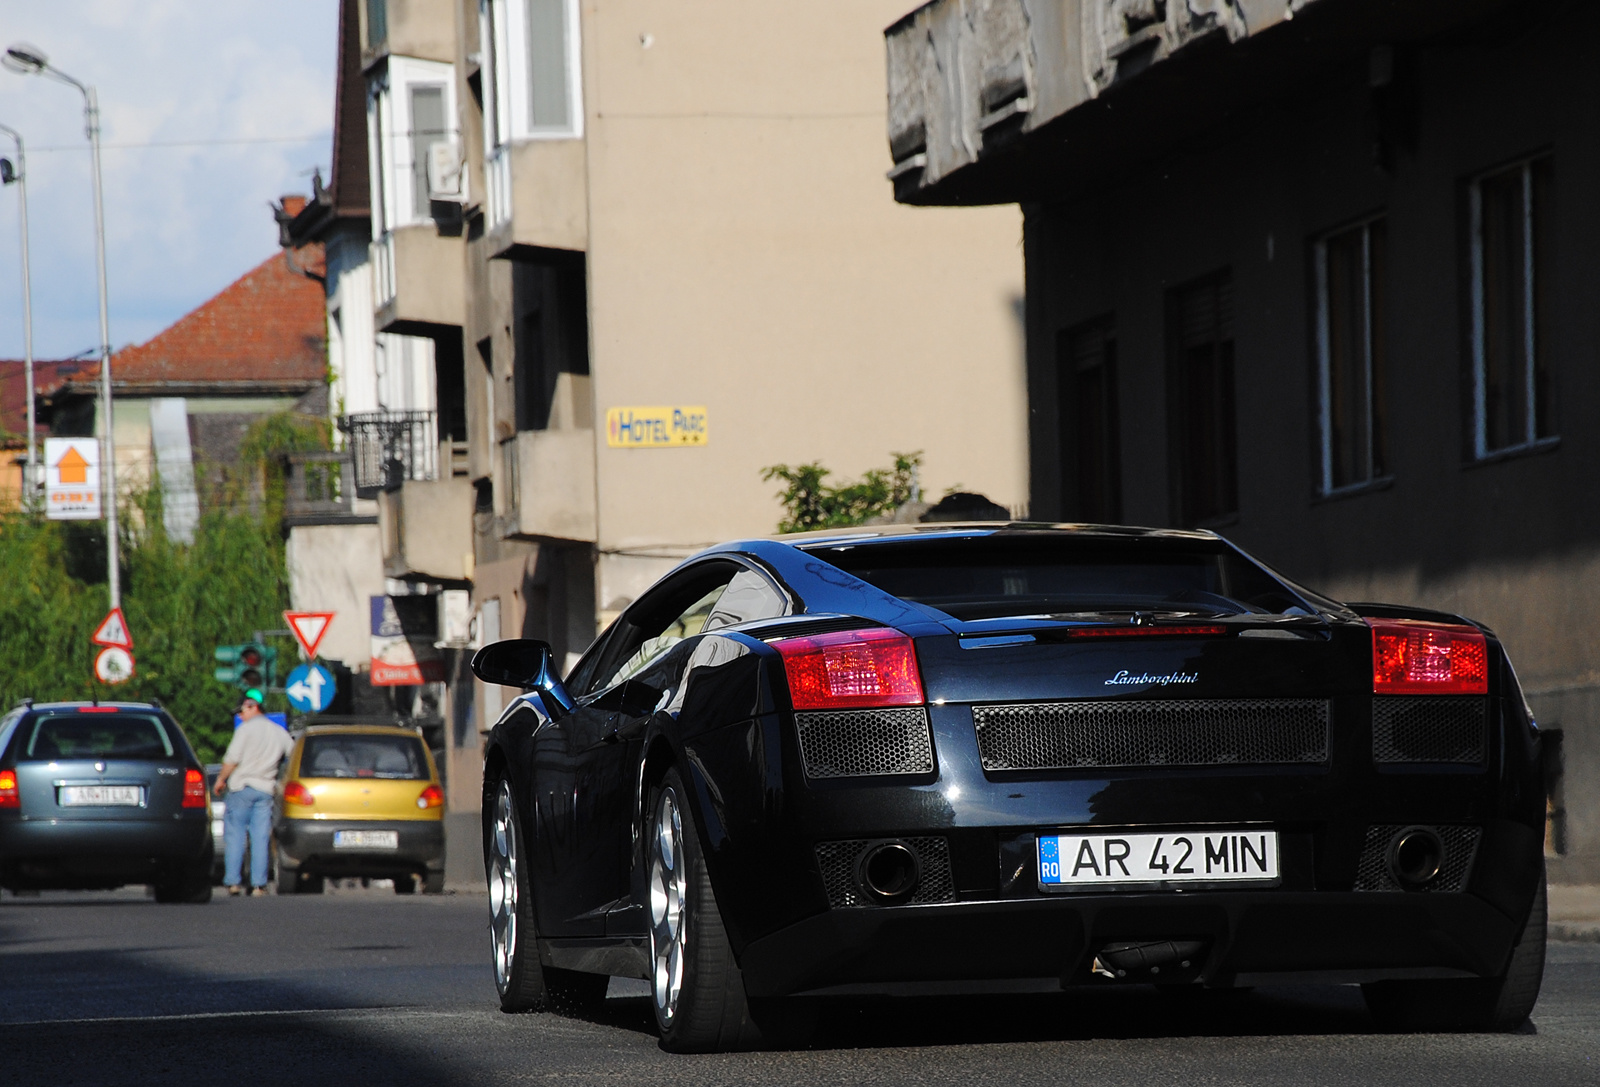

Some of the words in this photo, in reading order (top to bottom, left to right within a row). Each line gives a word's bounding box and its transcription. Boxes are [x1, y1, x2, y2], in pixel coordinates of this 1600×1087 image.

[1104, 669, 1199, 686] Lamborghini
[1071, 839, 1131, 877] AR
[1148, 837, 1194, 874] 42
[1204, 835, 1268, 873] MIN
[1041, 861, 1059, 878] RO
